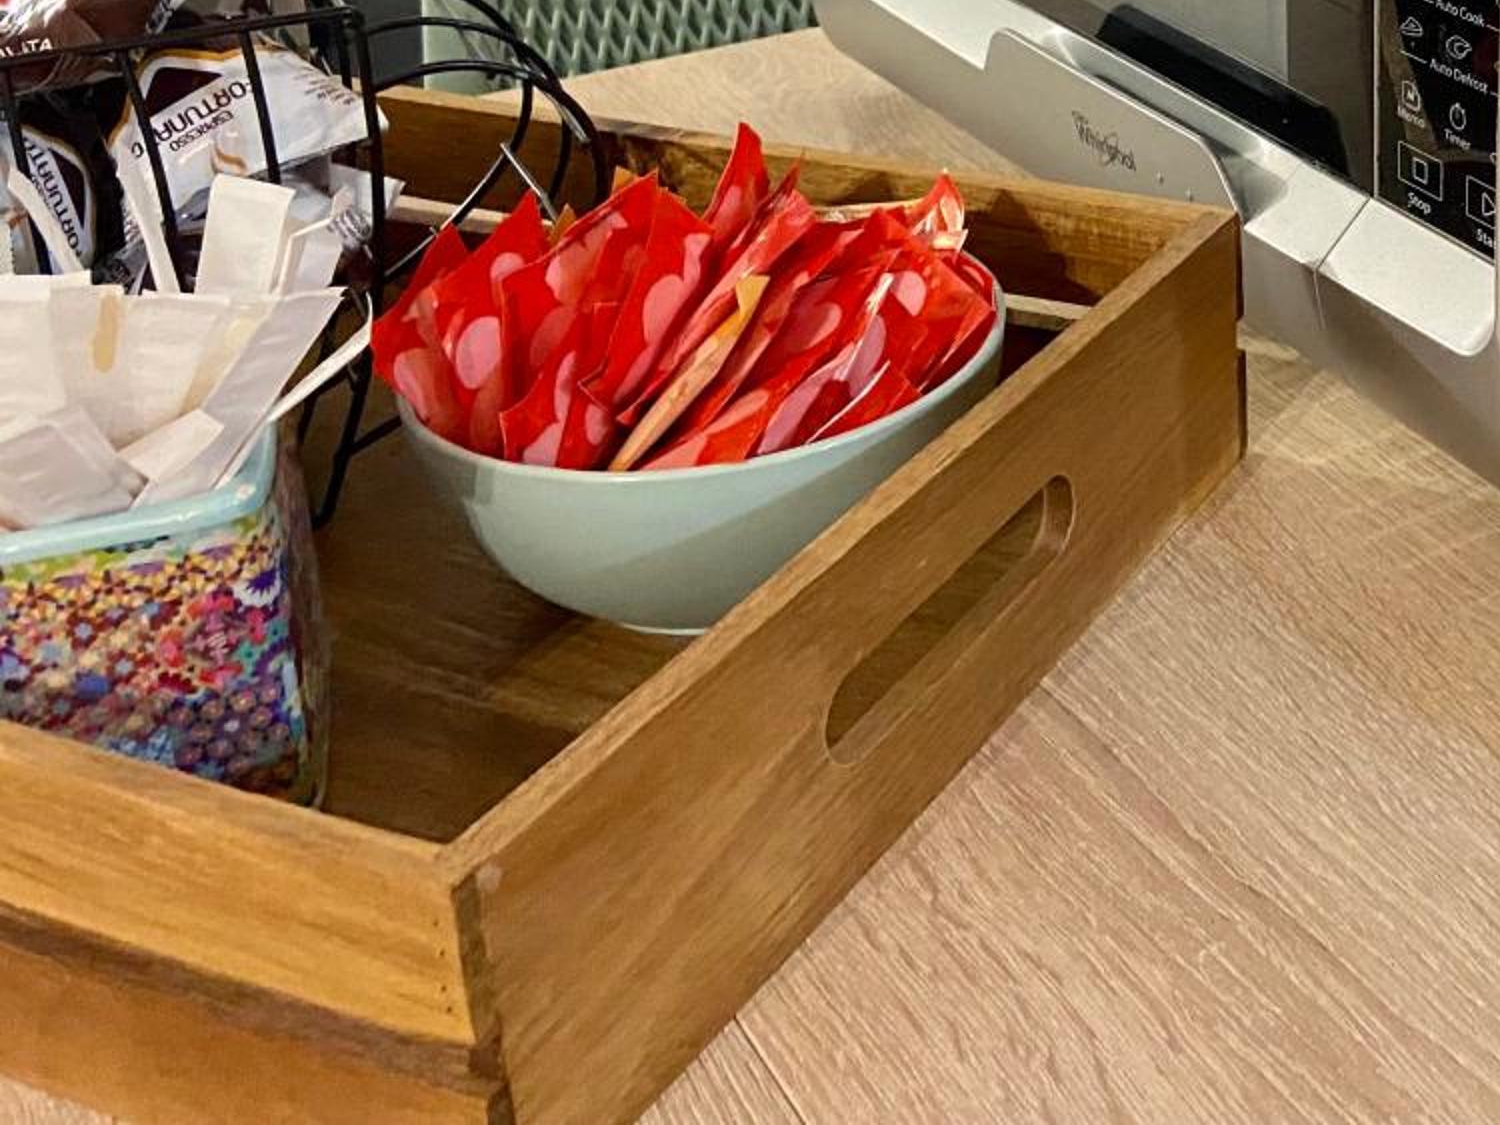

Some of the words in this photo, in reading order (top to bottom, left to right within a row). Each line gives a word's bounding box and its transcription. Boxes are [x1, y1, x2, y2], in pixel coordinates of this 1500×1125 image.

[1459, 6, 1485, 28] Cook
[1429, 58, 1453, 78] Auto
[1453, 68, 1488, 94] Defrost
[130, 80, 251, 159] ORTUNAO
[169, 109, 234, 153] ESPRESSO
[1443, 127, 1472, 151] Timer
[1407, 191, 1432, 216] Stop
[1475, 227, 1497, 249] Sta
